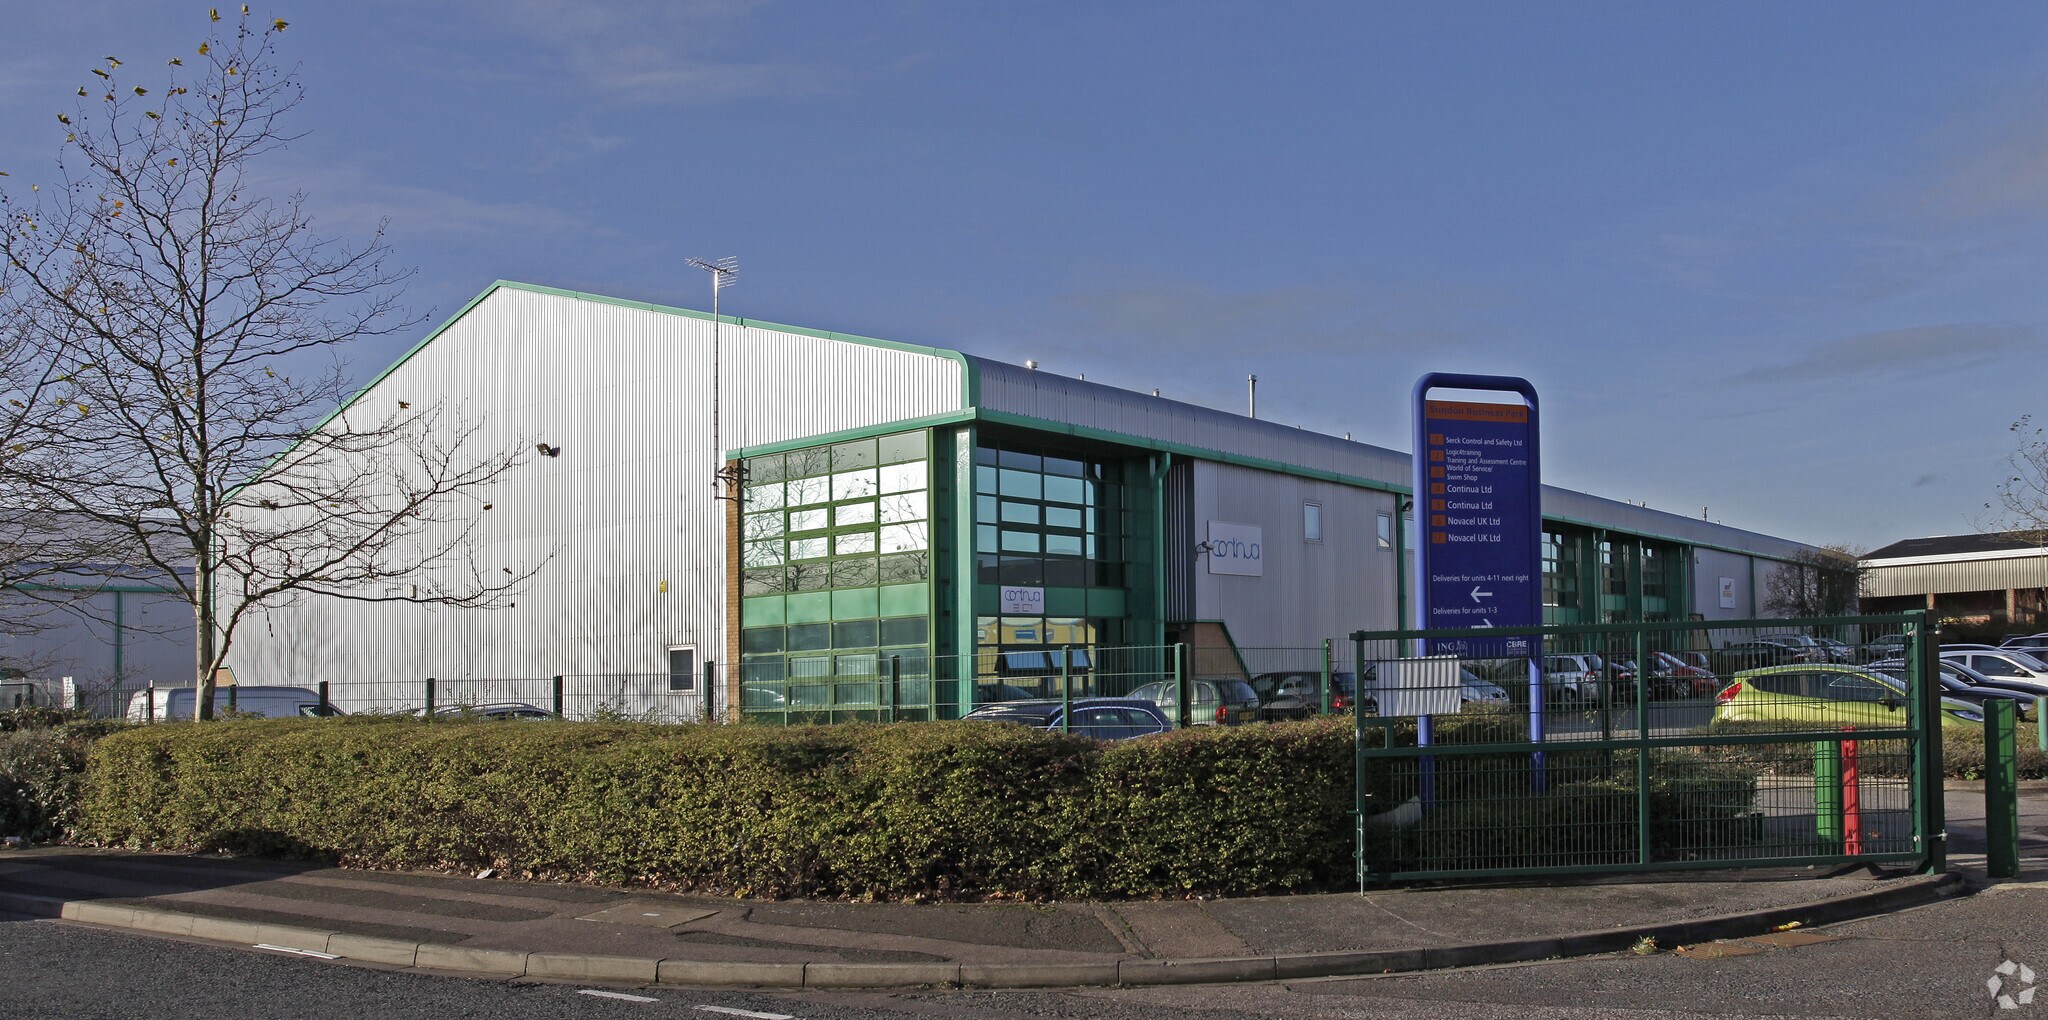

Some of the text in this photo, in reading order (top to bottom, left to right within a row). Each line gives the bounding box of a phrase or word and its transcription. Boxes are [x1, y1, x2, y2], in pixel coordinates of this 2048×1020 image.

[1466, 408, 1503, 417] Business
[1506, 410, 1524, 418] Park
[1496, 439, 1512, 447] Safety
[1447, 457, 1467, 465] Training
[1464, 474, 1478, 482] Shop
[1447, 485, 1479, 493] Continua
[1481, 486, 1493, 494] Ltd
[1448, 501, 1480, 509] Continua
[1482, 502, 1493, 510] Ltd
[1448, 517, 1476, 526] Novacel
[1478, 518, 1488, 526] UK
[1490, 518, 1501, 526] Ltd
[1449, 534, 1476, 542] Novacel
[1478, 534, 1488, 542] UK
[1490, 534, 1501, 542] Ltd
[1515, 575, 1529, 583] right
[1437, 642, 1454, 651] ING
